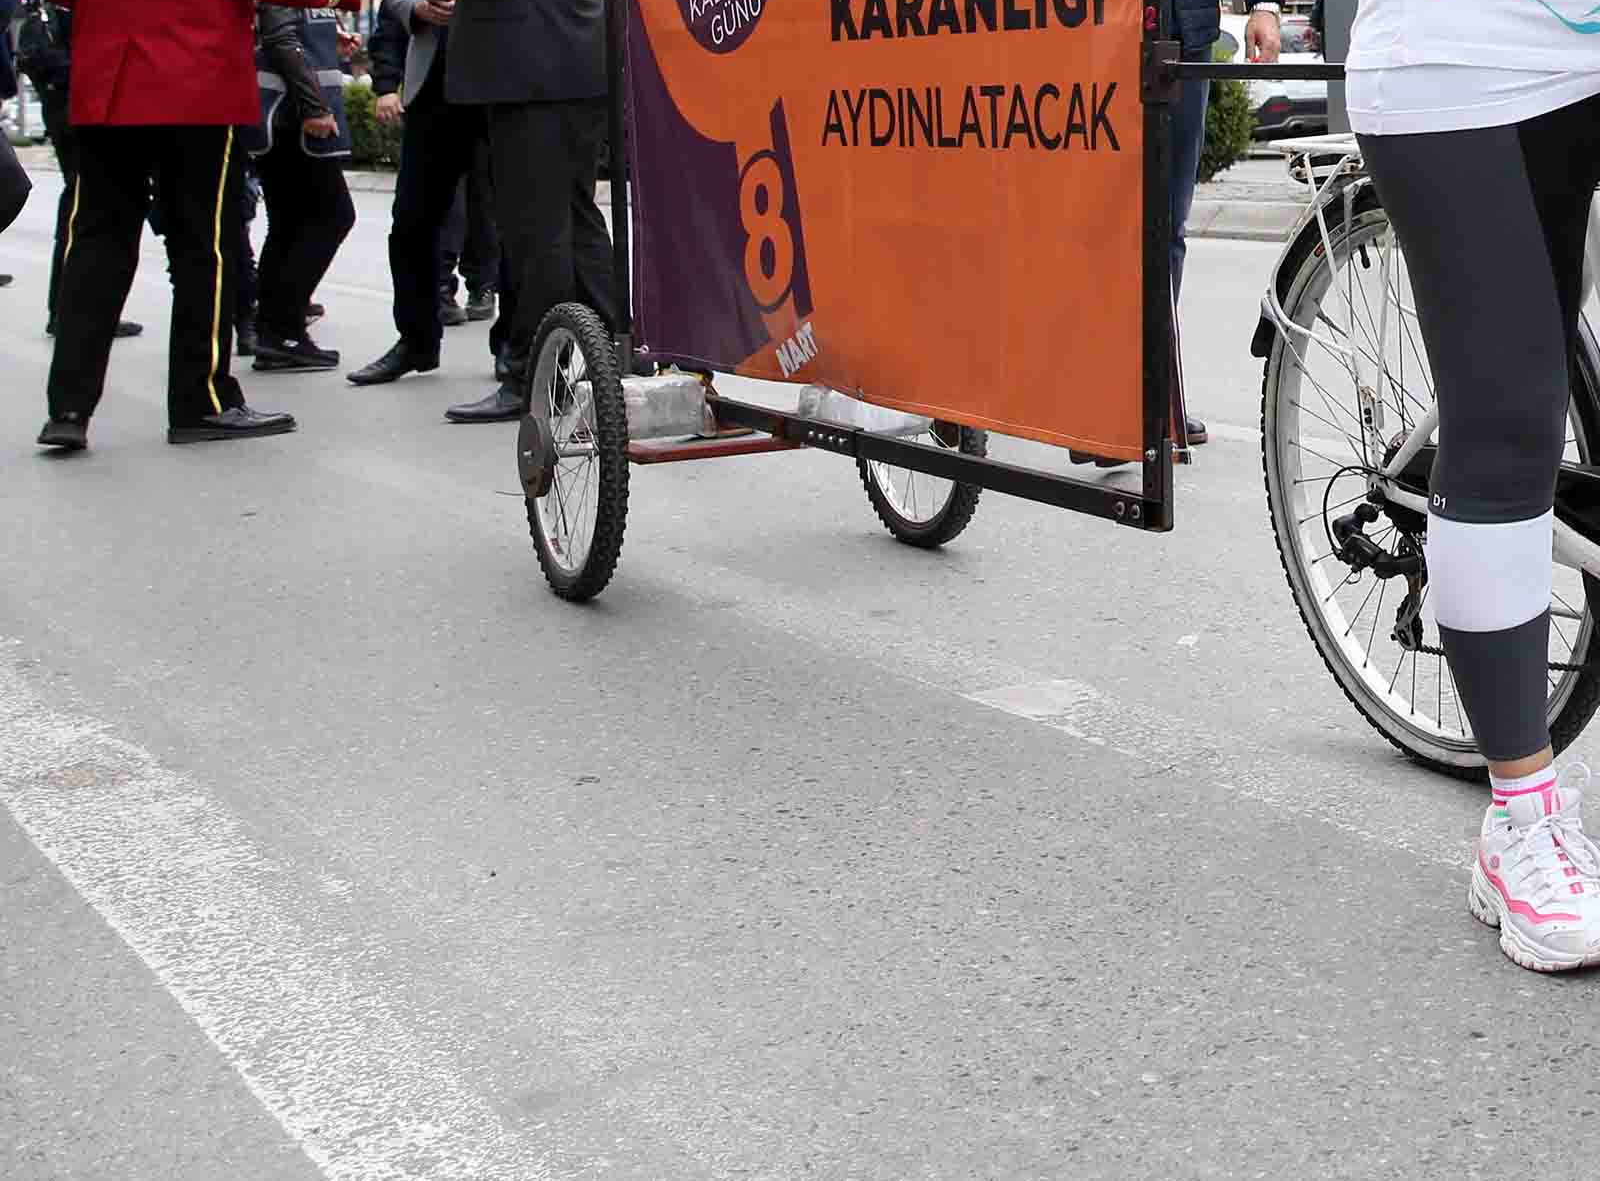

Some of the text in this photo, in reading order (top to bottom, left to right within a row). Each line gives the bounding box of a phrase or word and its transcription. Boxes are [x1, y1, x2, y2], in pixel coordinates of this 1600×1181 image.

[821, 81, 1121, 152] AYDINLATACAK
[740, 156, 794, 307] 8
[775, 321, 818, 379] MART
